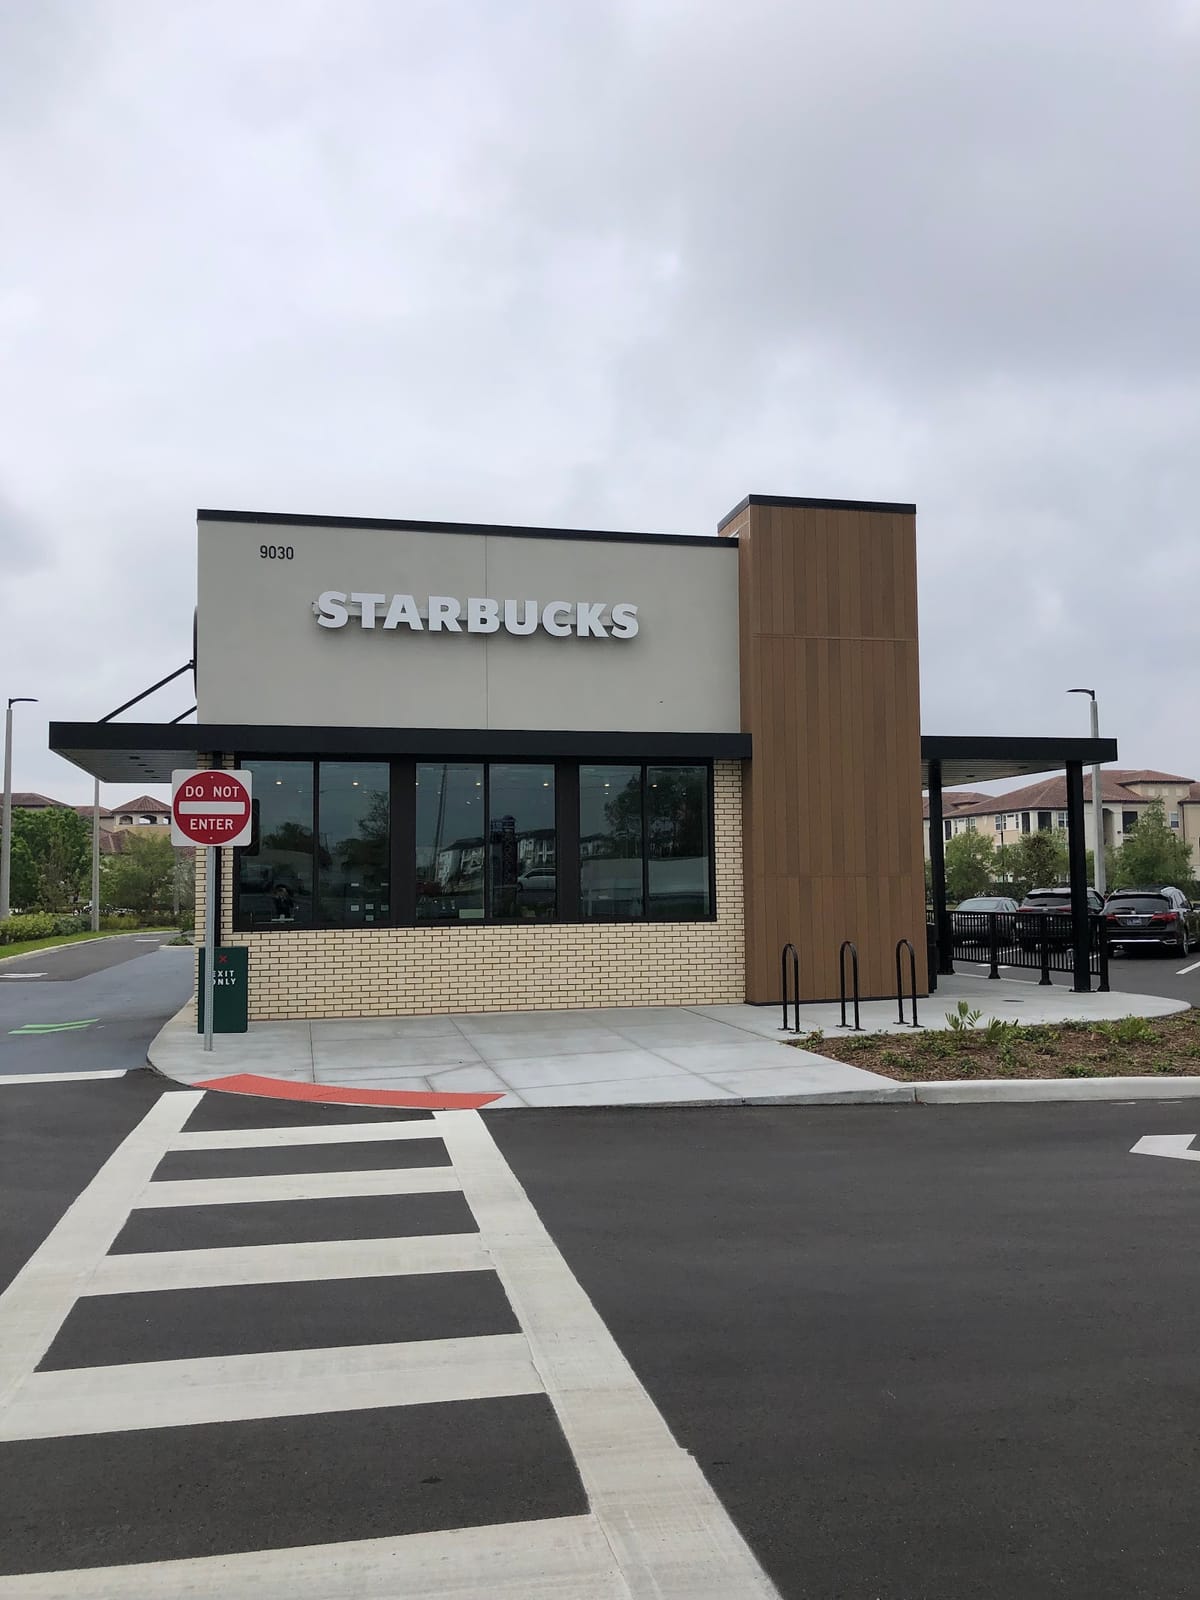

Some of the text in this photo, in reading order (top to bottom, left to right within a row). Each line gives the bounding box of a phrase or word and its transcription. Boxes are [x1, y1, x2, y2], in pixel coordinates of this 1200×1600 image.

[260, 545, 294, 560] 9030
[317, 591, 639, 639] STARBUCKS
[185, 786, 240, 798] DO NOT
[190, 818, 234, 830] ENTER
